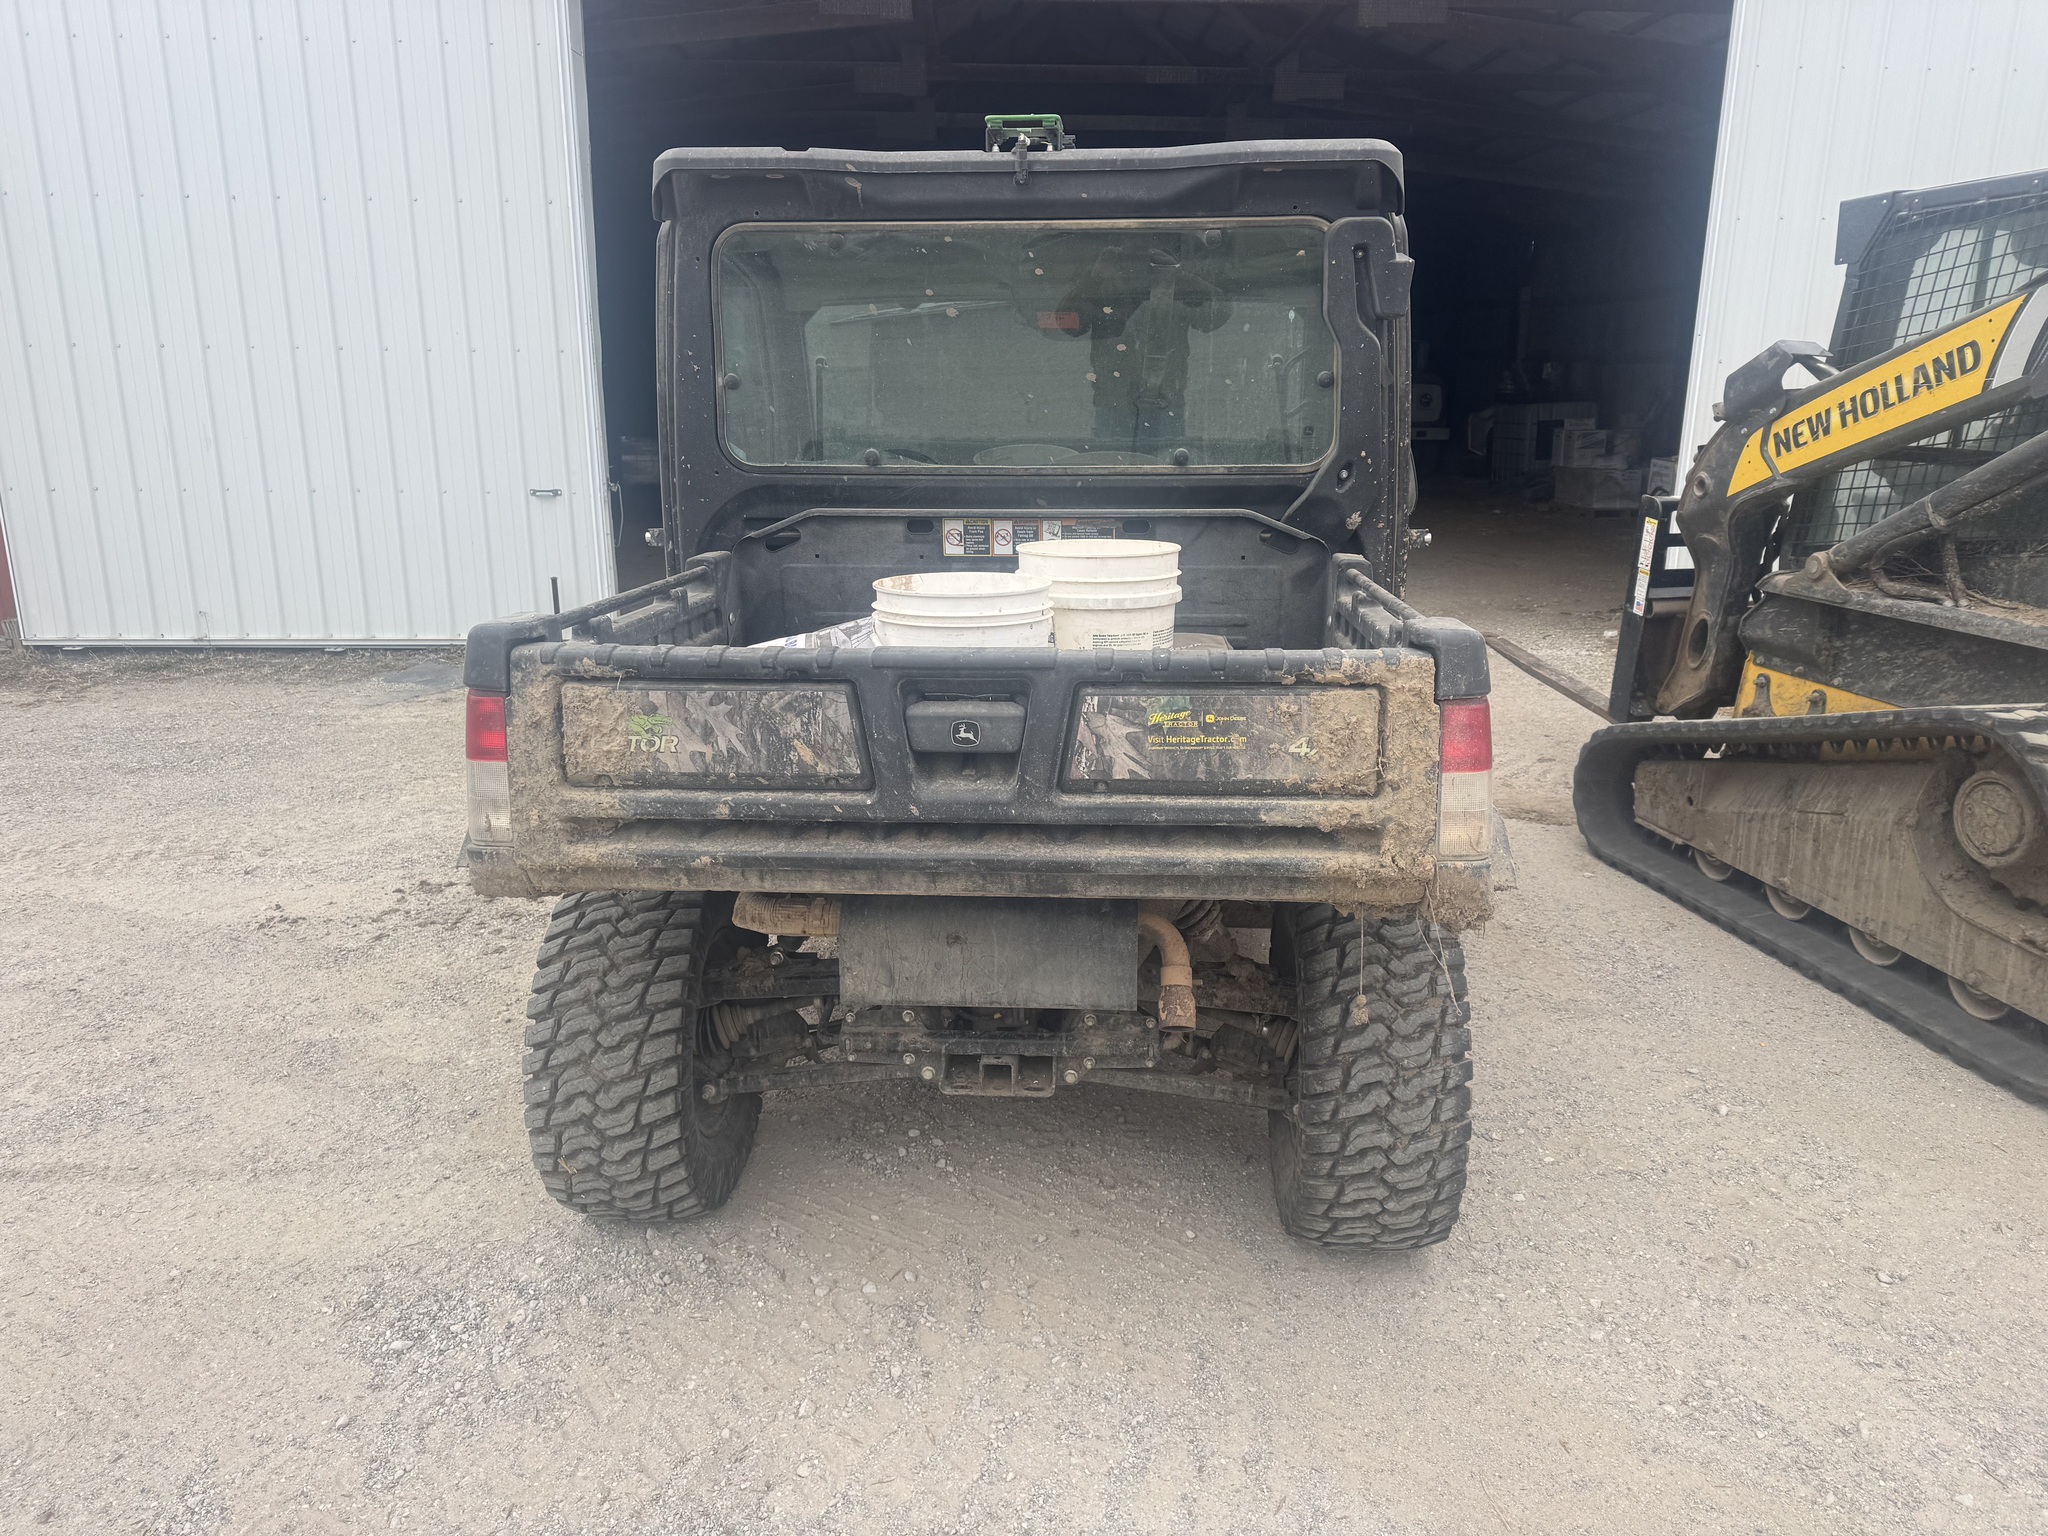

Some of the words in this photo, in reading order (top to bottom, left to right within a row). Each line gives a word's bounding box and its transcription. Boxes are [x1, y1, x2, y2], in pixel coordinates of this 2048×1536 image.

[1773, 403, 1831, 458] NEW
[1838, 339, 1982, 430] HOLLAND
[1147, 710, 1191, 726] Heritage
[1147, 735, 1164, 744] Visit
[1166, 735, 1247, 745] HeritageTractor.cm
